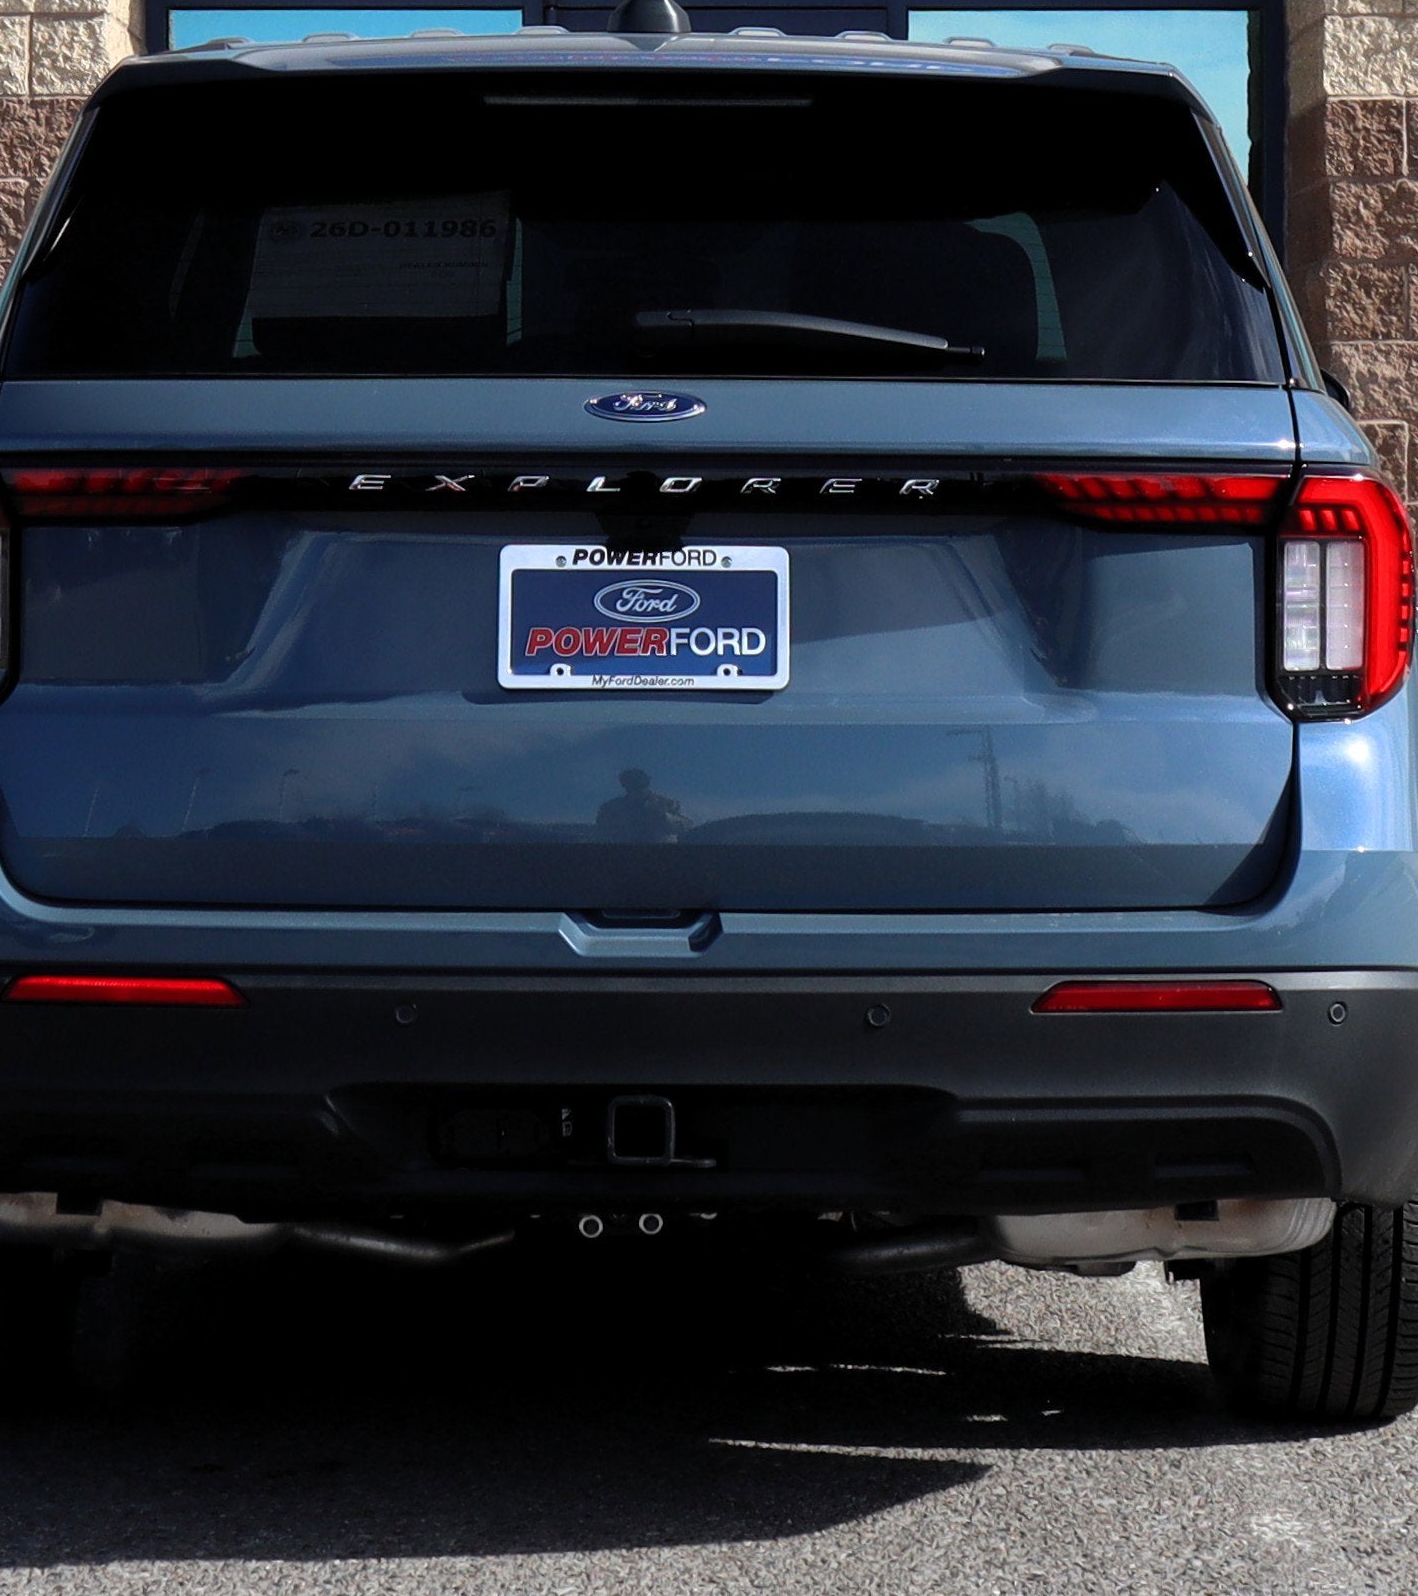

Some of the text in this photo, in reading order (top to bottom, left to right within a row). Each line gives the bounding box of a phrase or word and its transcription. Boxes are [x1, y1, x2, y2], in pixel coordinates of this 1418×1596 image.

[309, 219, 497, 238] 26D-011986
[613, 394, 677, 411] Ford
[348, 474, 940, 494] EXPLORER
[572, 548, 717, 566] POWERFORD
[615, 586, 679, 613] Ford
[525, 627, 766, 657] POWERFORD
[591, 674, 695, 688] MyFordDealer.com
